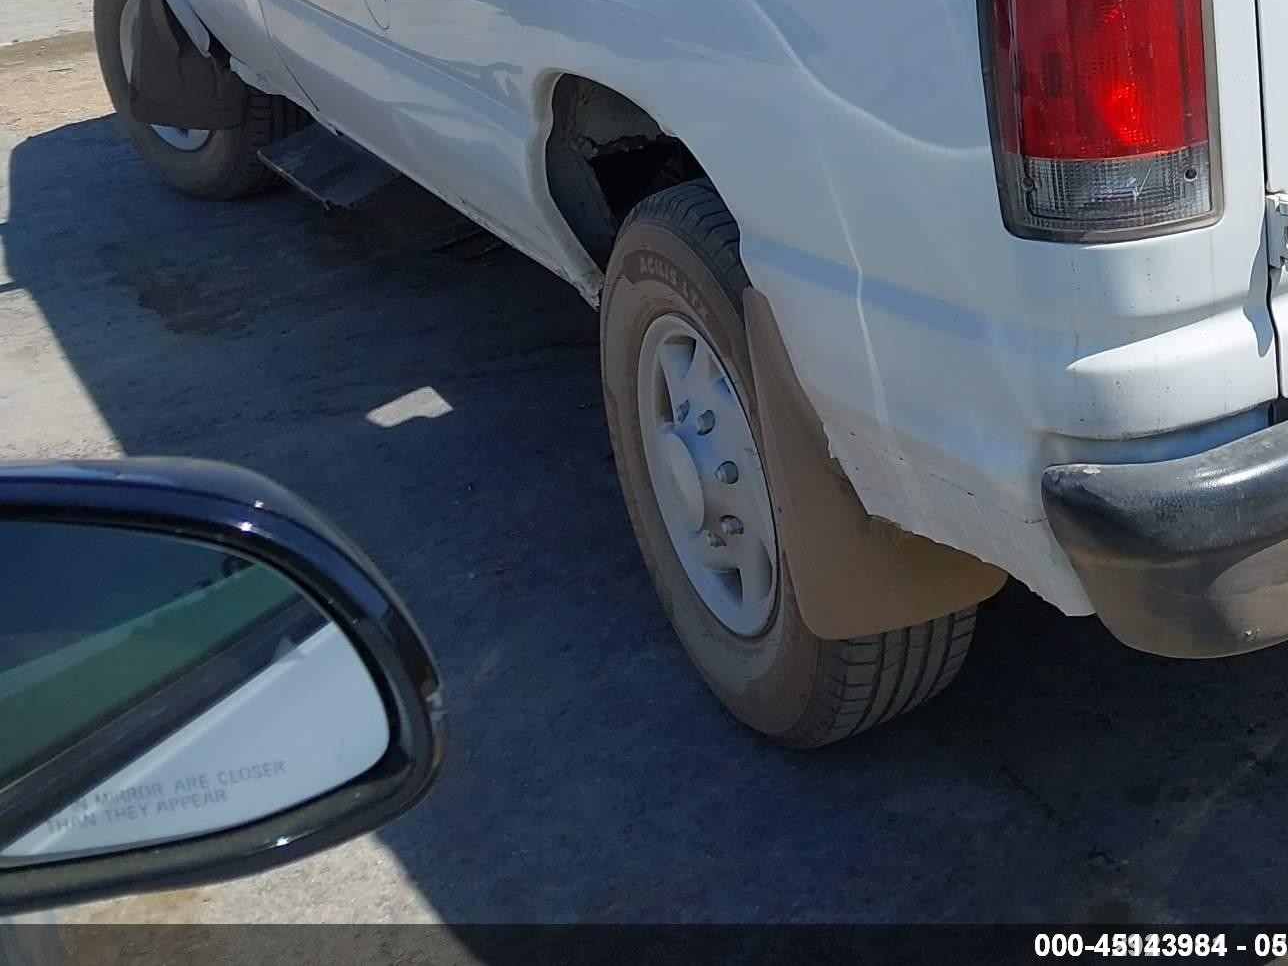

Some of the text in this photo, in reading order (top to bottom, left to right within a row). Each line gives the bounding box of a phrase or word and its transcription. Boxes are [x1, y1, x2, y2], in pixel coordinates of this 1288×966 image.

[94, 783, 164, 806] MIRROR
[174, 774, 210, 793] ARE
[217, 760, 287, 786] CLOSER
[105, 804, 148, 823] THEY
[156, 789, 228, 814] APPEAR
